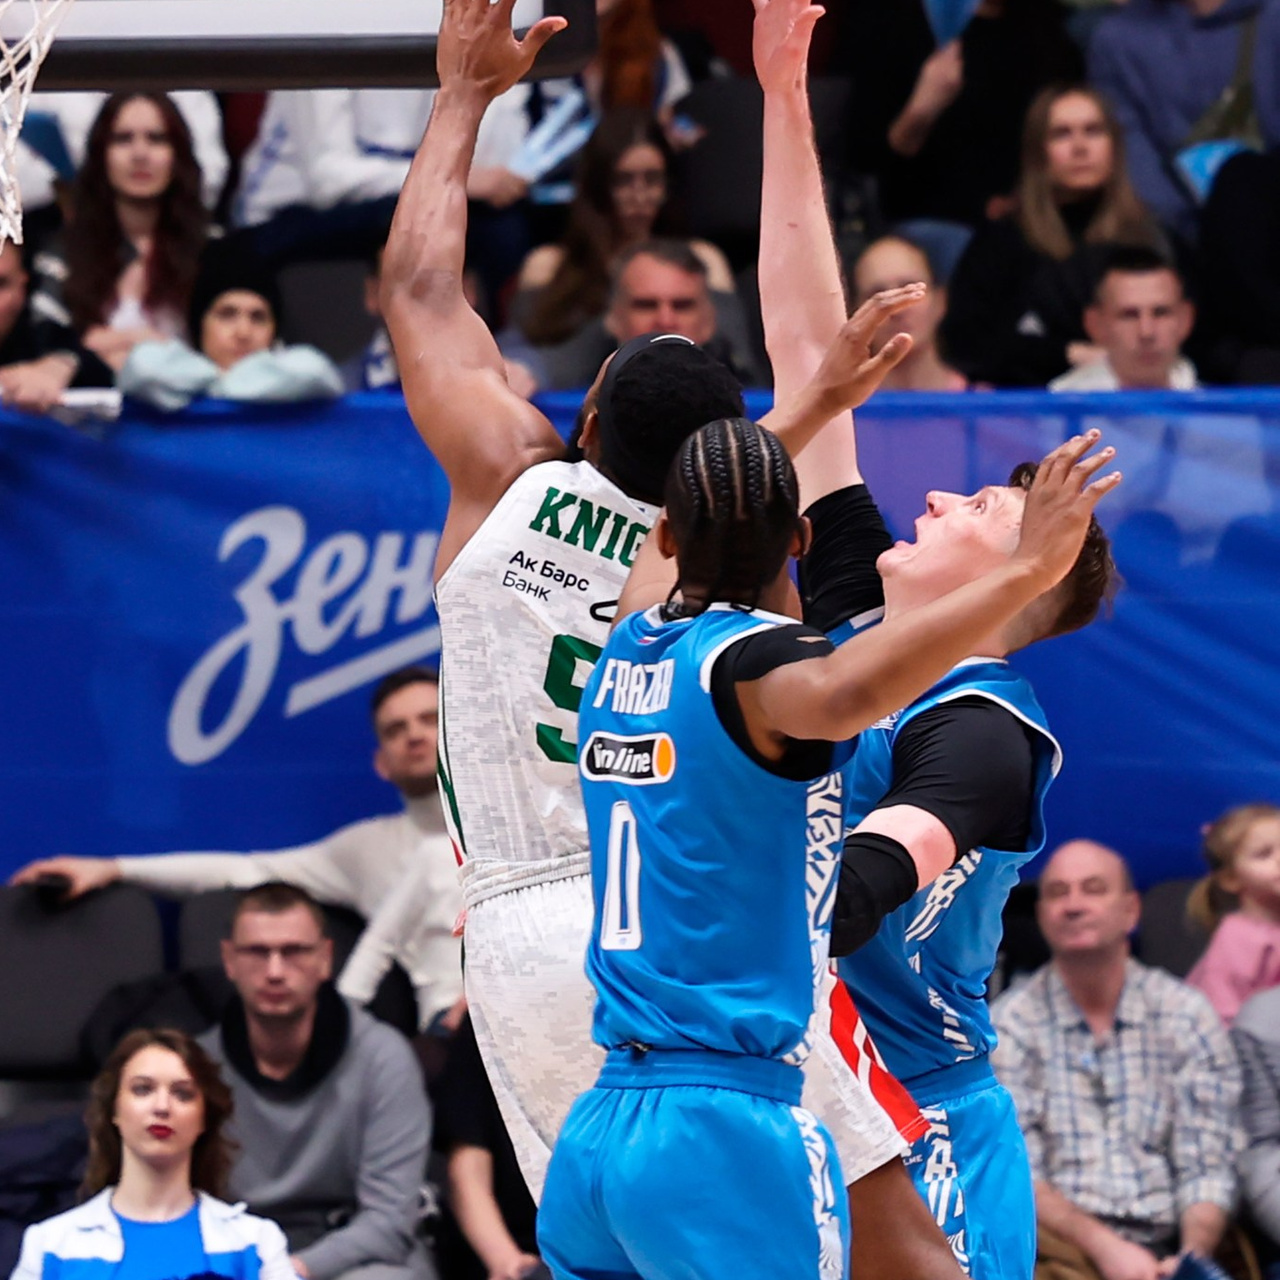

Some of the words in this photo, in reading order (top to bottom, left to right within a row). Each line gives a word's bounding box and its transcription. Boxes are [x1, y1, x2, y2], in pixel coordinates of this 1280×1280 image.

[528, 486, 651, 568] KNIG
[502, 570, 552, 602] Банк
[509, 550, 538, 572] Ак
[540, 560, 590, 592] Барс
[167, 504, 441, 766] Зен
[600, 800, 642, 950] 0
